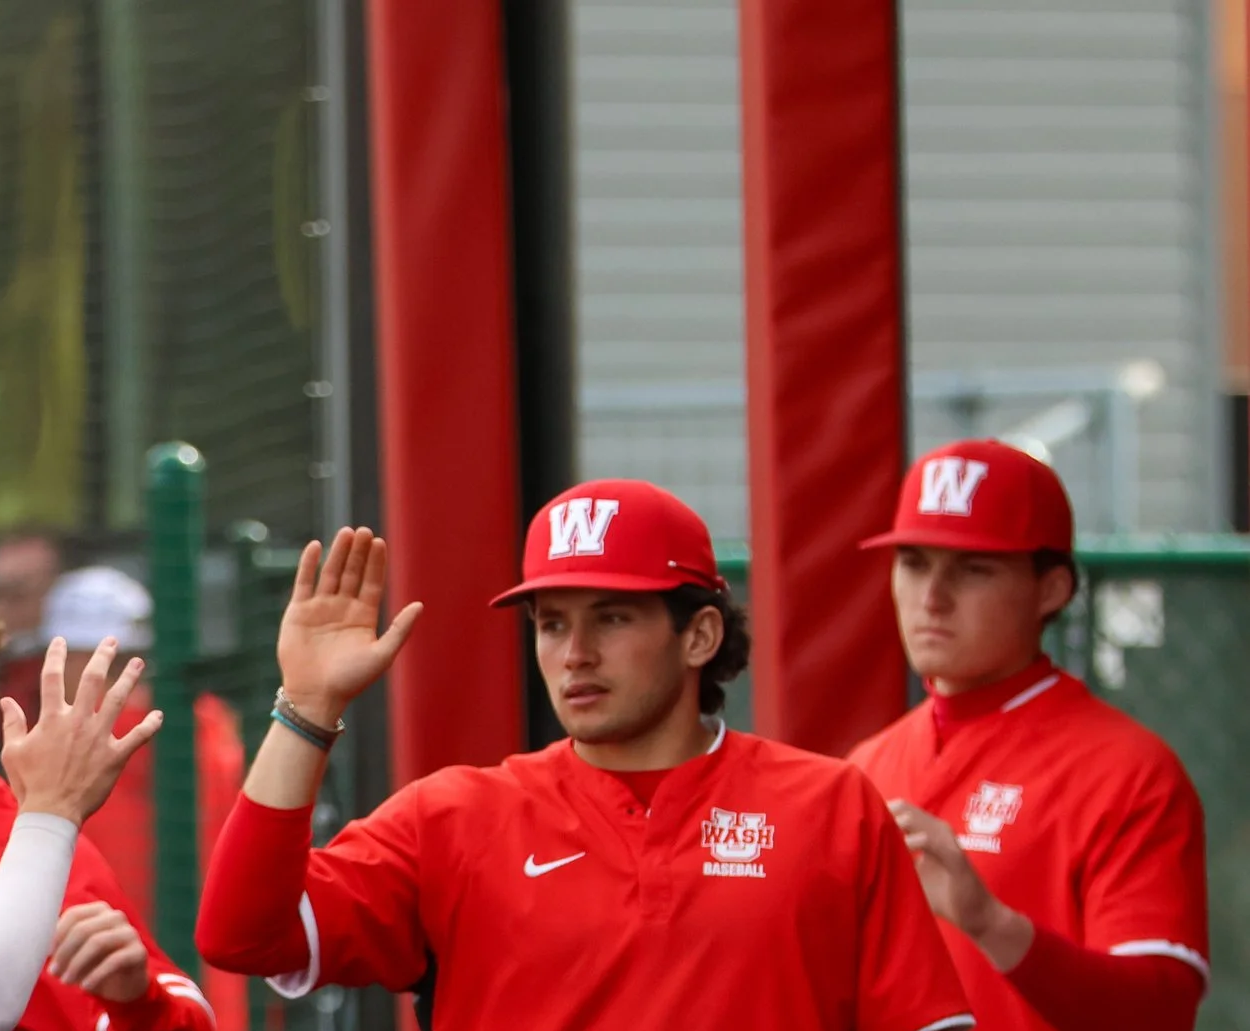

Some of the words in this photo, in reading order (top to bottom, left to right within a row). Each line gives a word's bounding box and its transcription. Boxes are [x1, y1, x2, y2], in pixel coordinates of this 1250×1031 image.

[917, 456, 989, 517] W
[548, 497, 619, 560] W
[701, 820, 774, 850] WASH
[710, 807, 766, 862] U
[702, 862, 766, 878] BASEBALL
